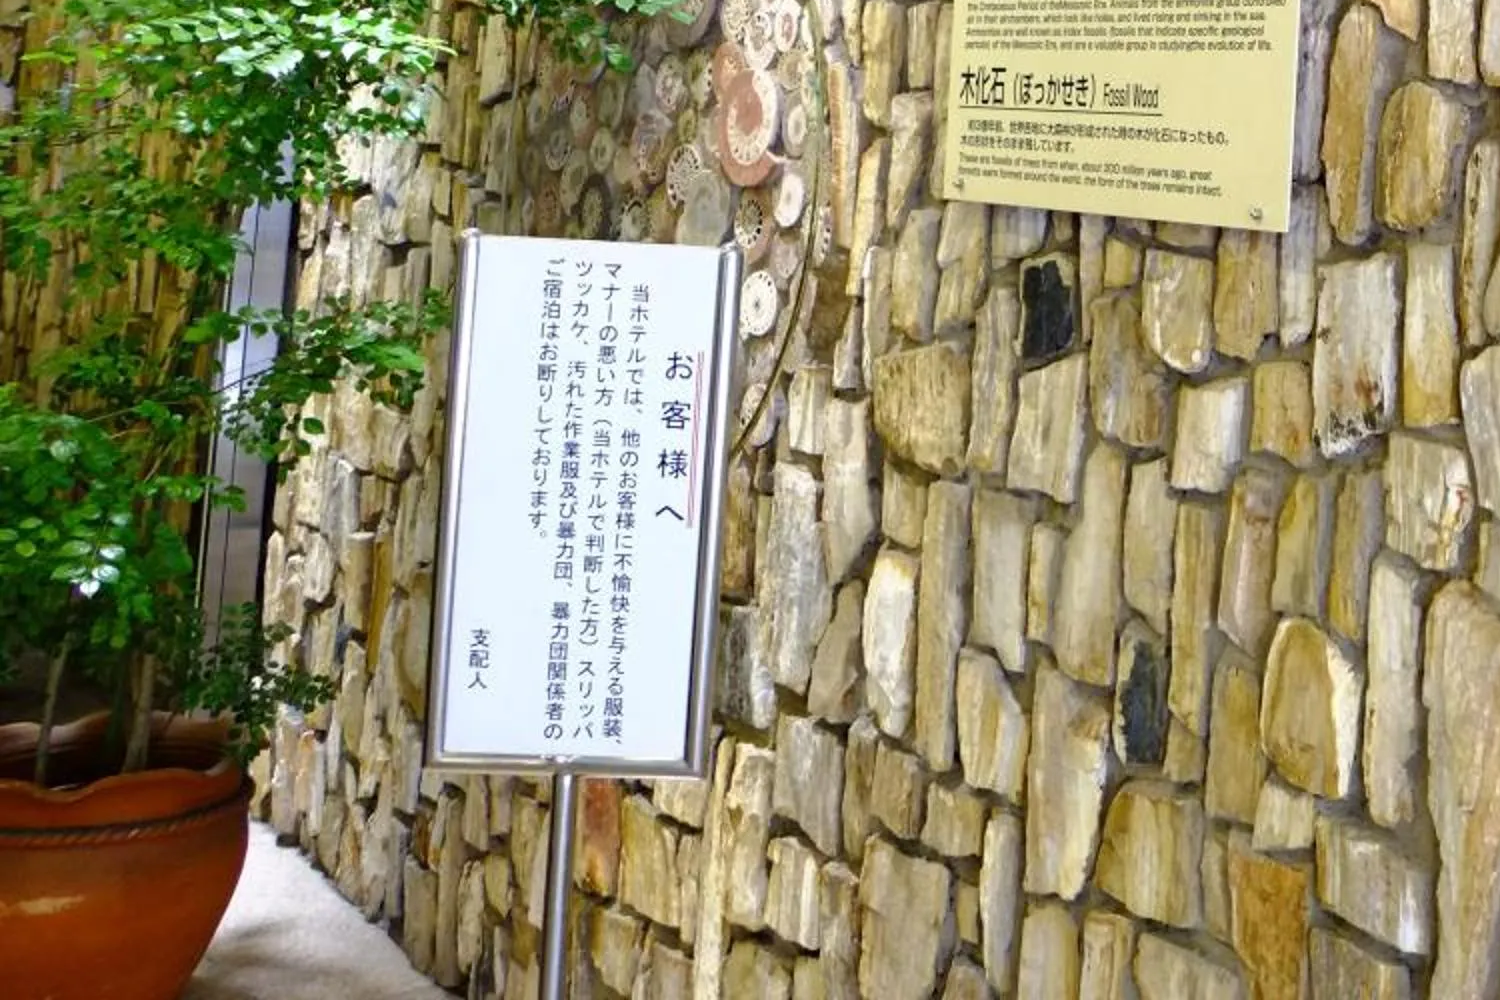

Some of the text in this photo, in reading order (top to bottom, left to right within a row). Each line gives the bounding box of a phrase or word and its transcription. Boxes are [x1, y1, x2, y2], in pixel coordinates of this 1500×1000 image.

[1103, 83, 1131, 108] Fossil
[1133, 84, 1159, 109] Wood
[655, 351, 695, 524] お客様へ
[468, 627, 491, 690] 支配人
